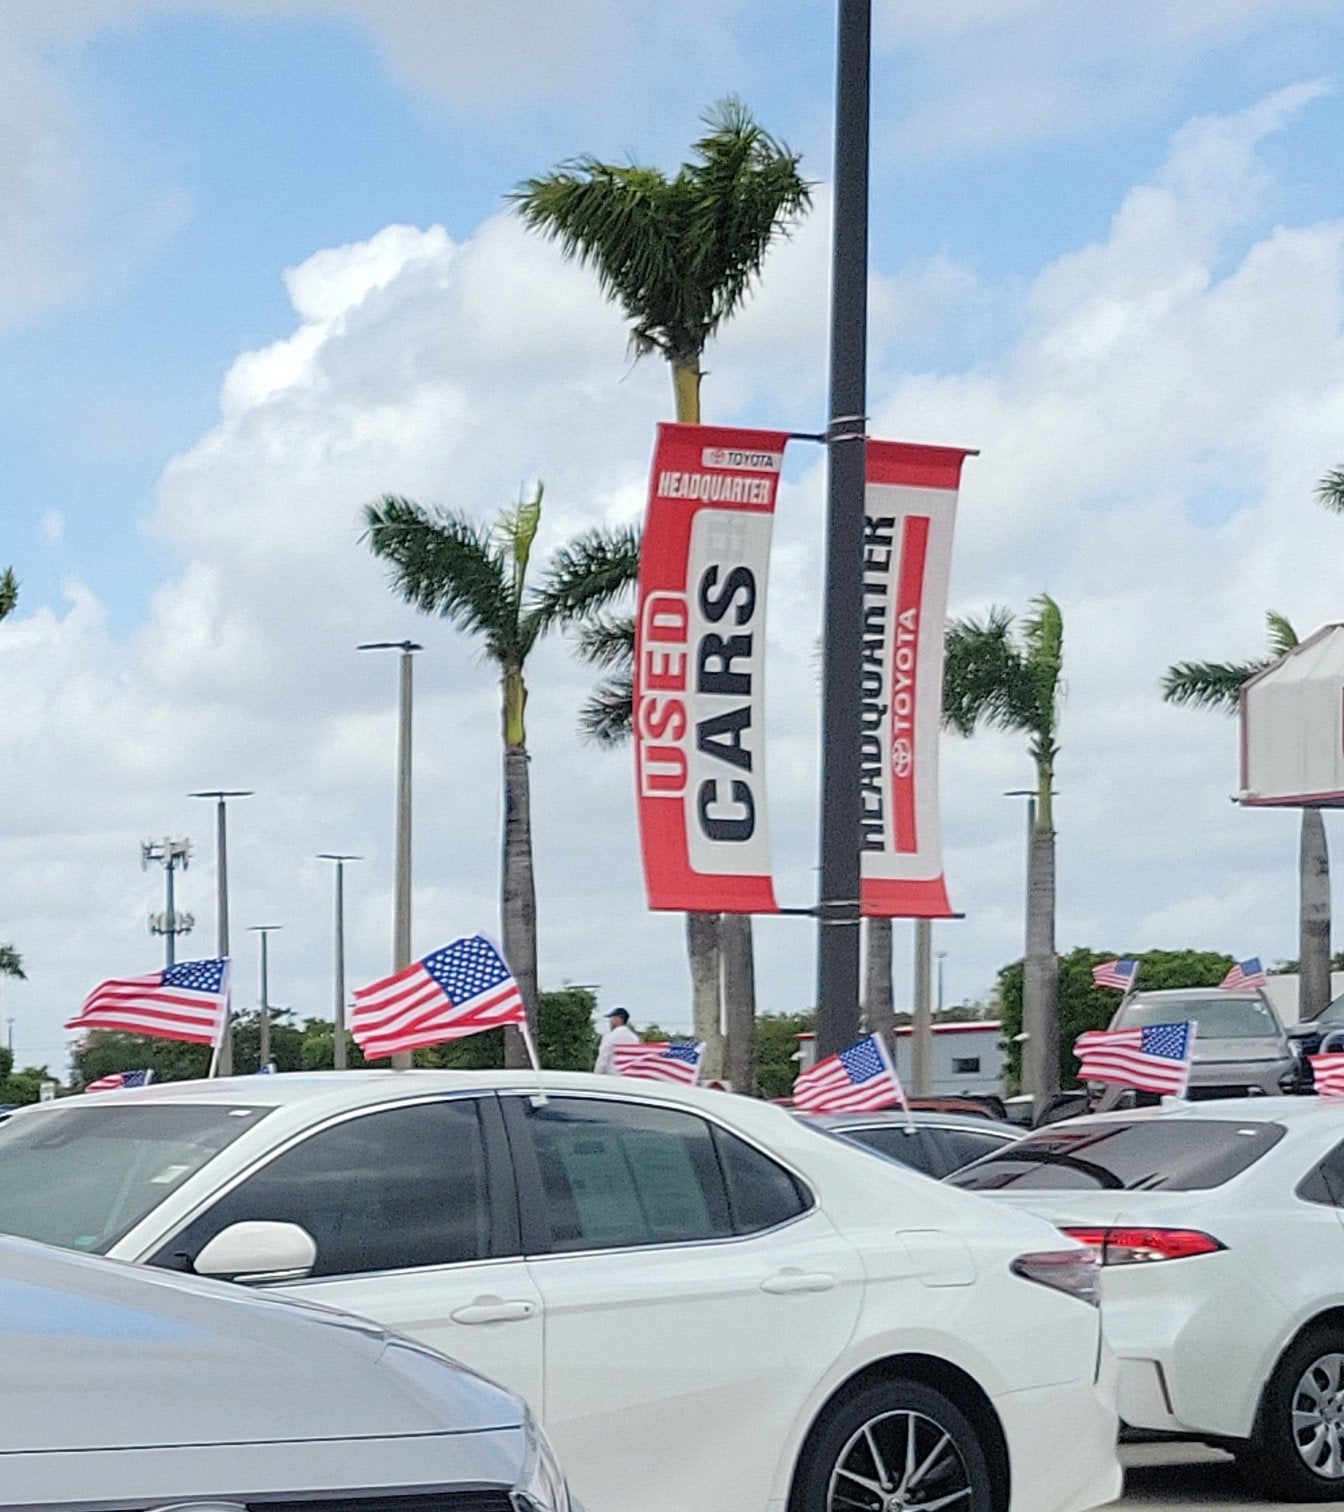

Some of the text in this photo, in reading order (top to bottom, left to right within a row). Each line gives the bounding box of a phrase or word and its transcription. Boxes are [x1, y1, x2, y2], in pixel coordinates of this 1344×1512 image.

[657, 471, 771, 504] HEADQUARTER
[727, 452, 773, 467] TOYOTA
[642, 596, 689, 793] USED
[697, 564, 756, 842] CARS
[894, 607, 917, 731] TOYOTA
